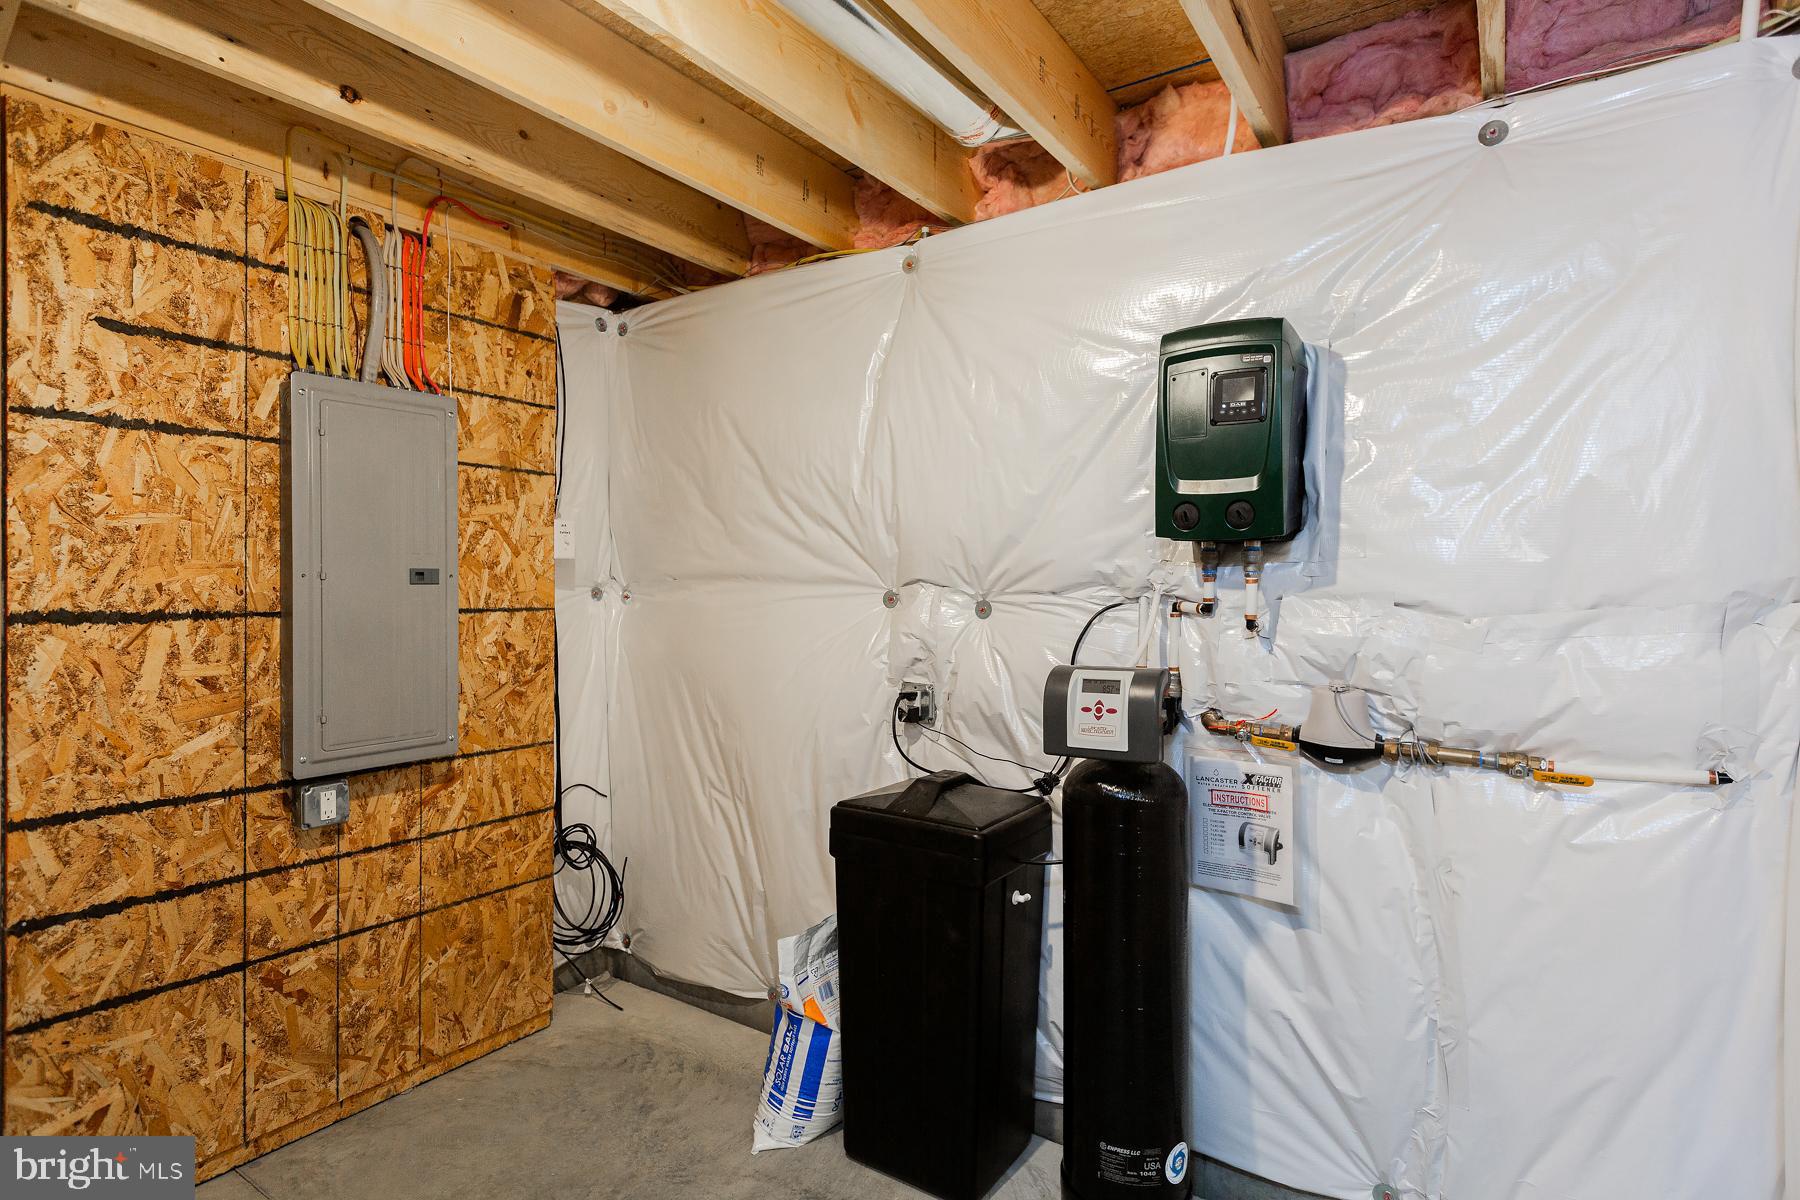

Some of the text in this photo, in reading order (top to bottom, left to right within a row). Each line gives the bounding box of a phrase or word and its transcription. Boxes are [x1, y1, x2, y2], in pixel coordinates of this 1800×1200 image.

[1195, 775, 1238, 785] LANCASTER
[1255, 775, 1283, 785] FACTOR
[1242, 785, 1281, 793] SOFTENER
[1213, 793, 1265, 808] INSTRUCTIONS
[775, 1023, 793, 1086] SOLAR SALT
[1143, 1161, 1161, 1170] USA
